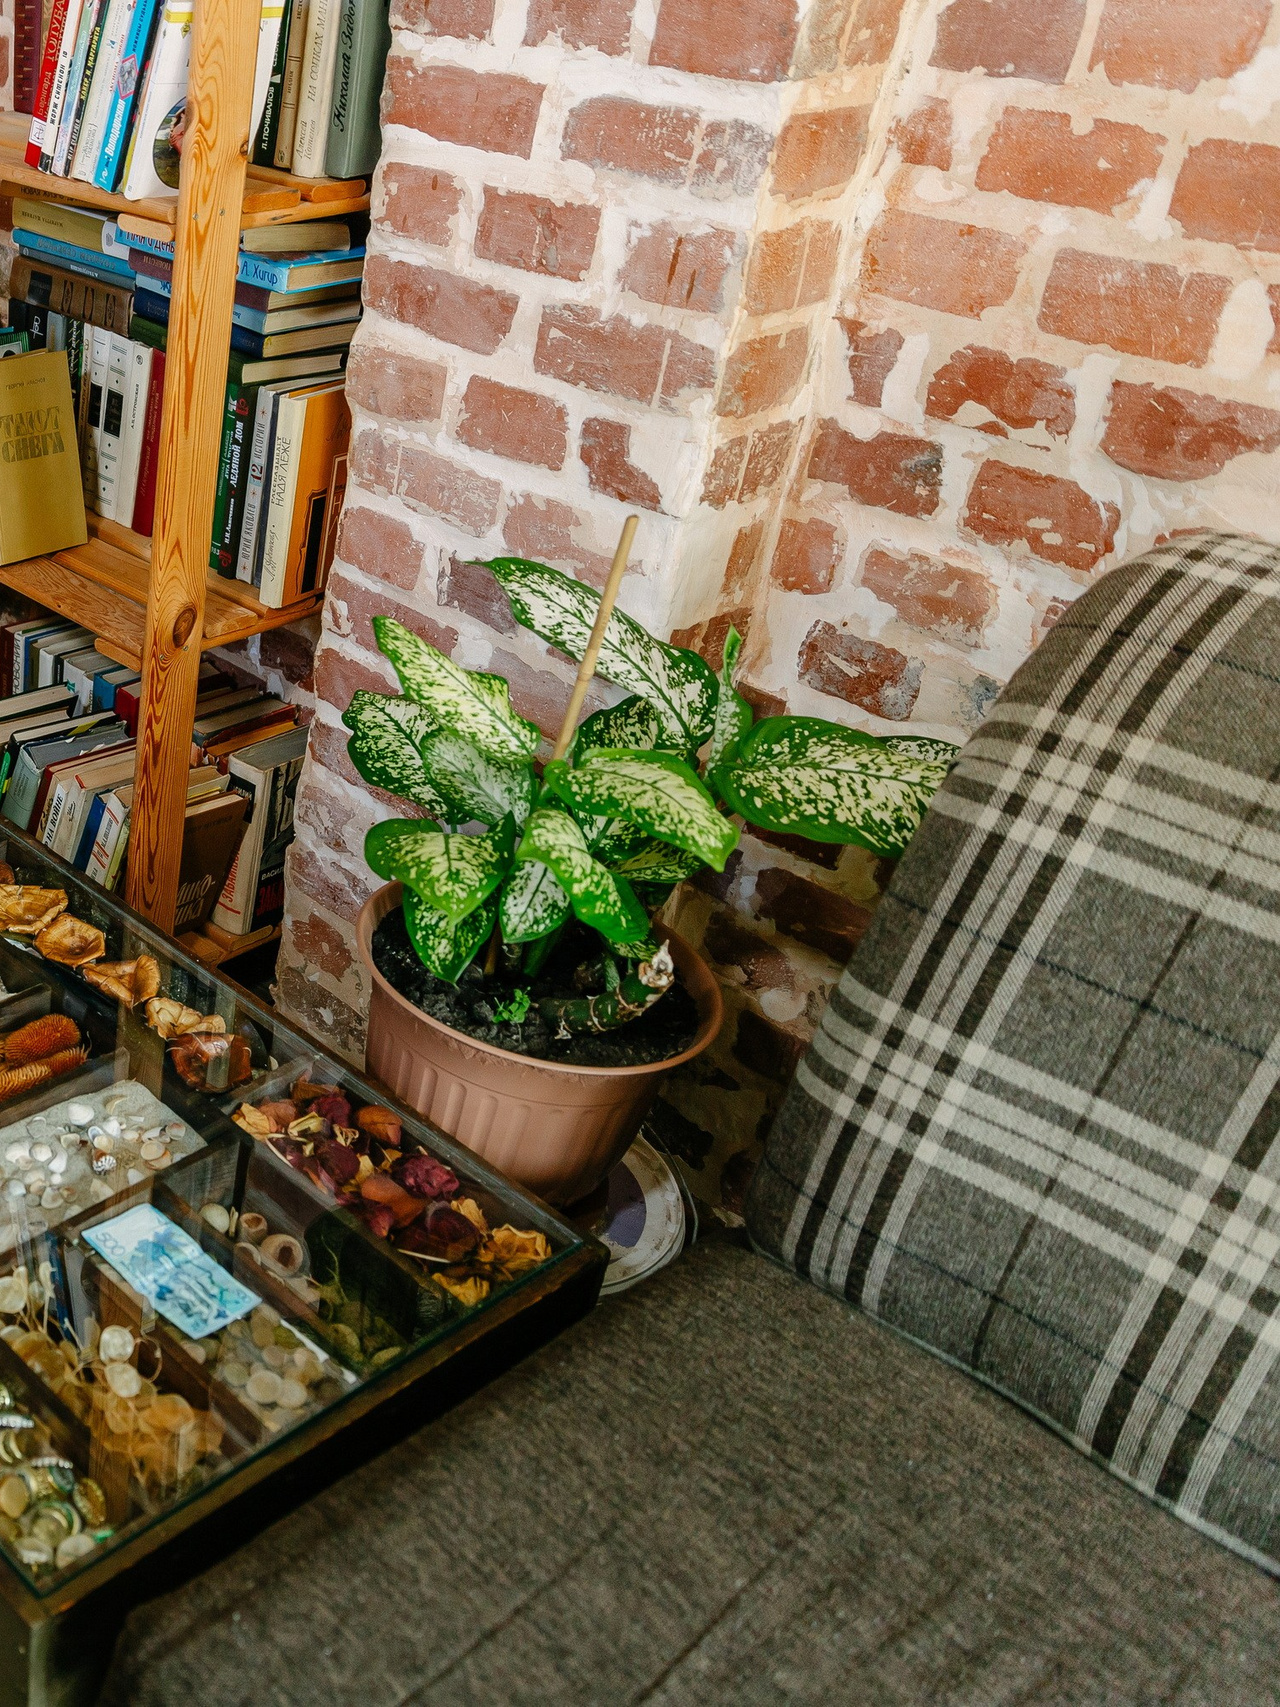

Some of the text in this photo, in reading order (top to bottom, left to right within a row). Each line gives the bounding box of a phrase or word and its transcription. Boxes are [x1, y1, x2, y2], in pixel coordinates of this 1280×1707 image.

[47, 0, 65, 62] ГОЛУБА
[310, 32, 323, 81] СОПКАХ
[81, 79, 89, 100] ХАКЕР
[88, 27, 100, 68] МАРГАРИТА
[308, 85, 316, 102] НА
[333, 52, 351, 133] Николай
[50, 102, 59, 125] ЖОРЖ
[55, 64, 65, 99] СИМЕНОН
[297, 119, 307, 159] Алексей
[2, 431, 65, 463] СНЕГА
[229, 445, 241, 488] ЛЕДЯНОЙ
[235, 421, 244, 443] ДОМ
[271, 437, 282, 504] РАССКАЗЫВАЕТ
[275, 437, 291, 507] НАДЯ ЛЕЖЕ
[242, 421, 265, 560] ЮРИЙ ЯКОВЛЕВ 12 ИСТОРИЙ
[52, 793, 64, 829] ВОЙНЕ
[96, 1230, 126, 1258] 500
